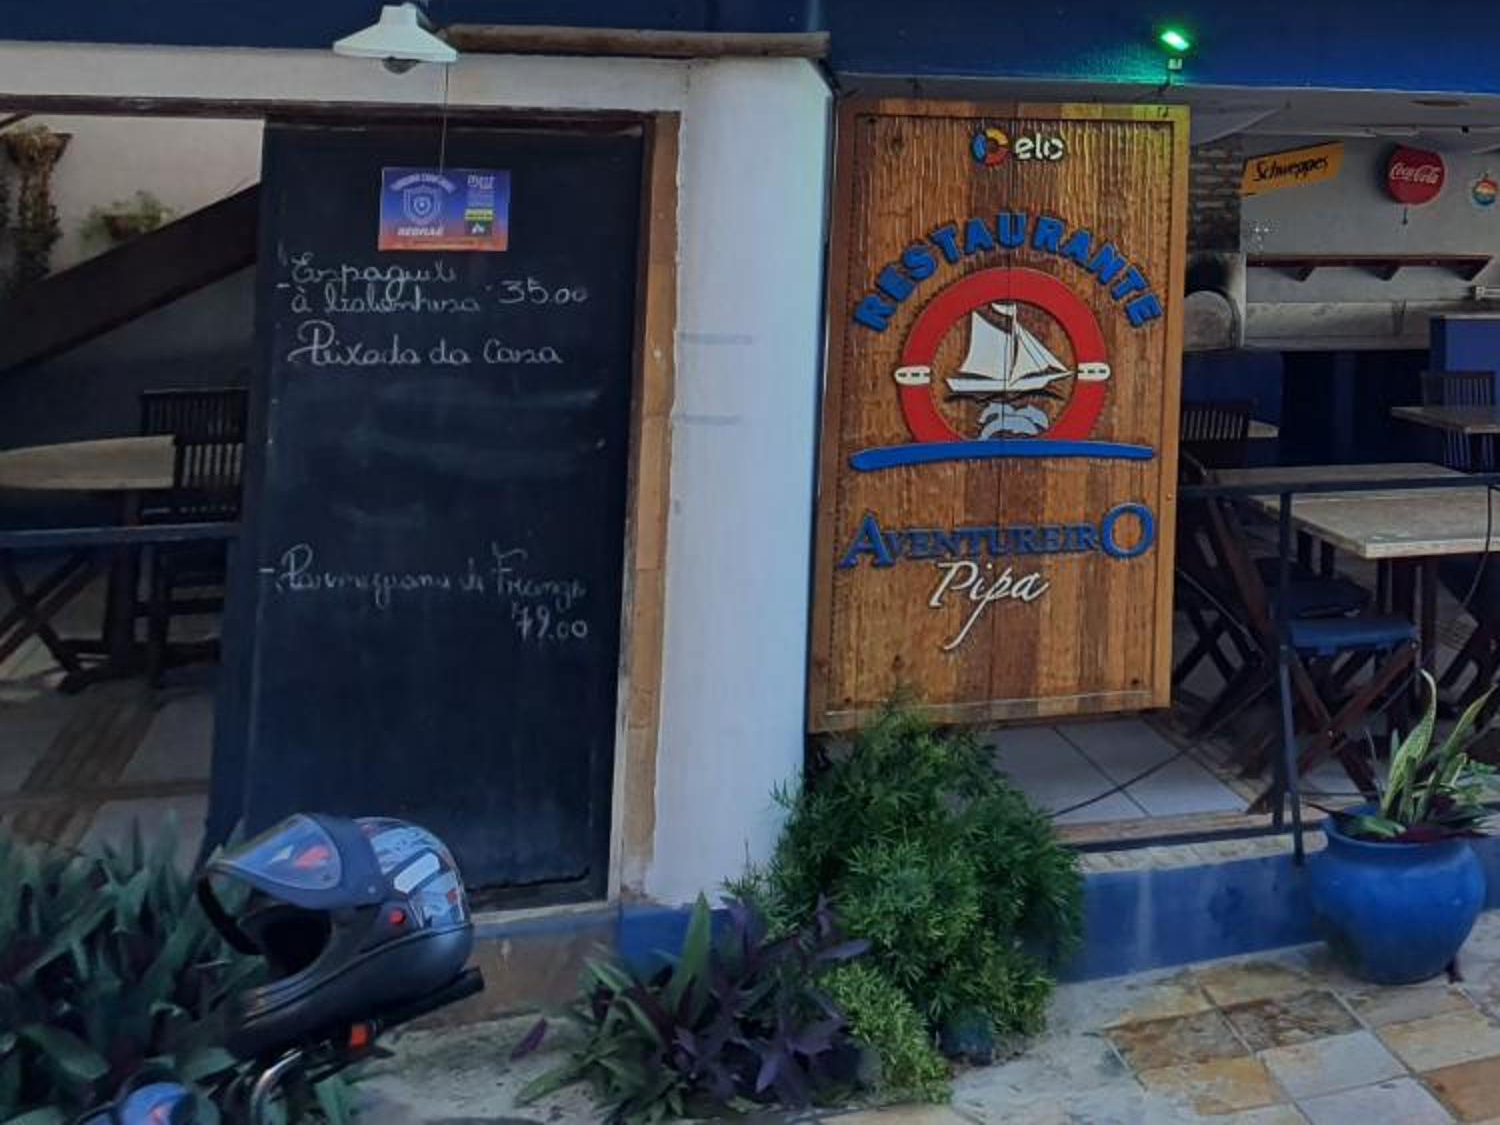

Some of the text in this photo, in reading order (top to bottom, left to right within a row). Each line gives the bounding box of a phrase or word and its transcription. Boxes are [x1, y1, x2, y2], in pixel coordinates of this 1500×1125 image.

[1015, 132, 1064, 160] elo
[1252, 155, 1329, 182] Schweppes
[853, 212, 1164, 333] RESTAURANTE
[429, 338, 472, 364] da
[483, 338, 563, 364] Casa
[929, 560, 1051, 651] Pipa
